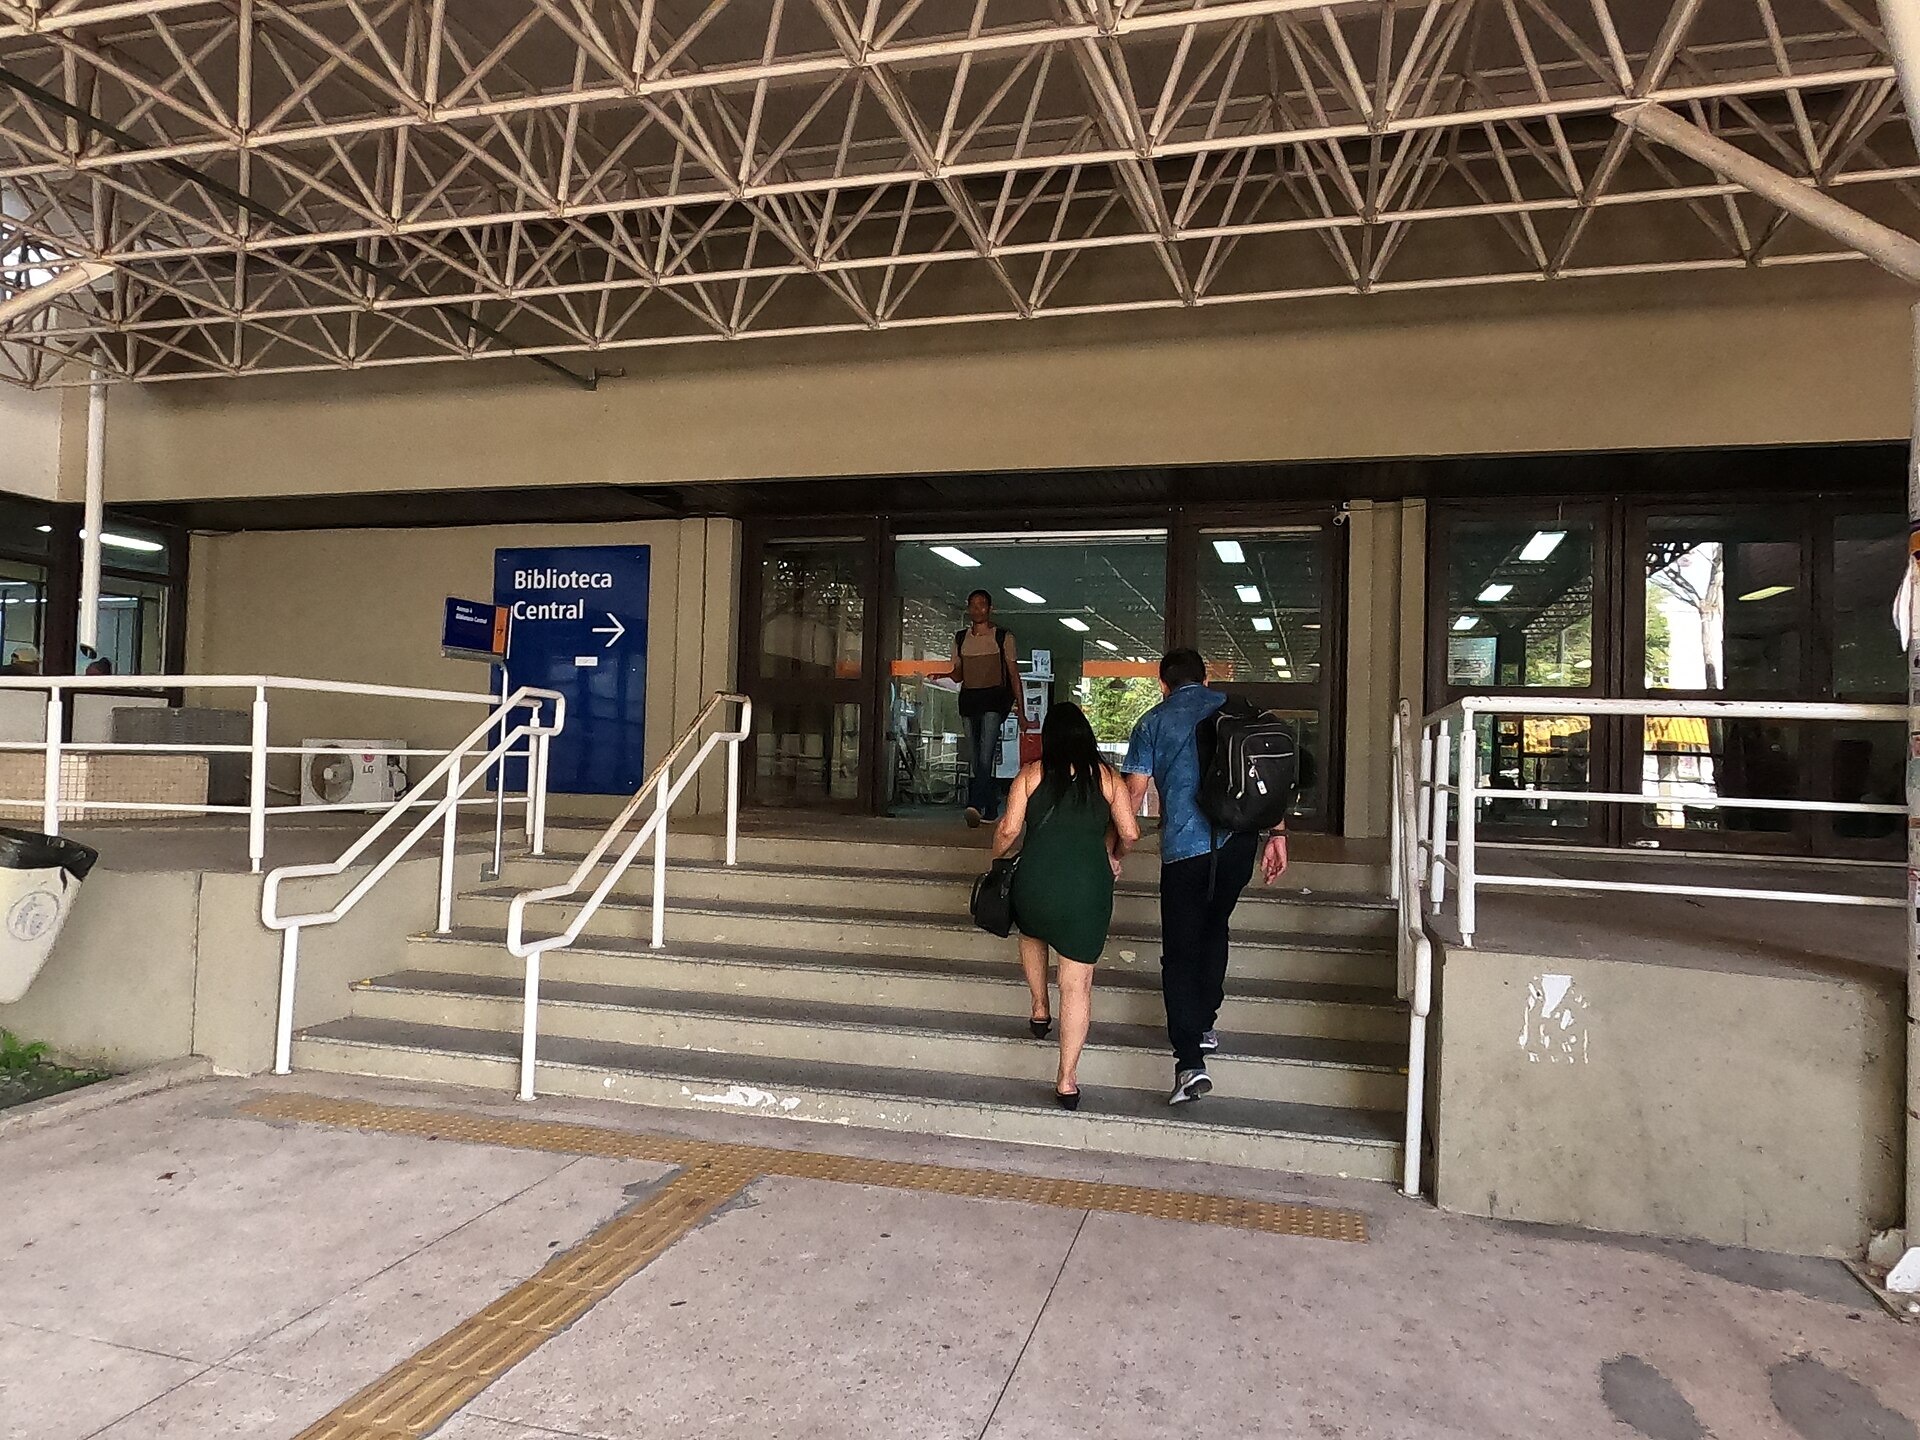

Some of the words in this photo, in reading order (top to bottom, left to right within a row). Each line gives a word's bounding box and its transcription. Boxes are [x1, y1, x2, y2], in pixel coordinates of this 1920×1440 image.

[514, 568, 612, 589] Biblioteca
[513, 599, 584, 620] Central
[362, 765, 375, 774] LG
